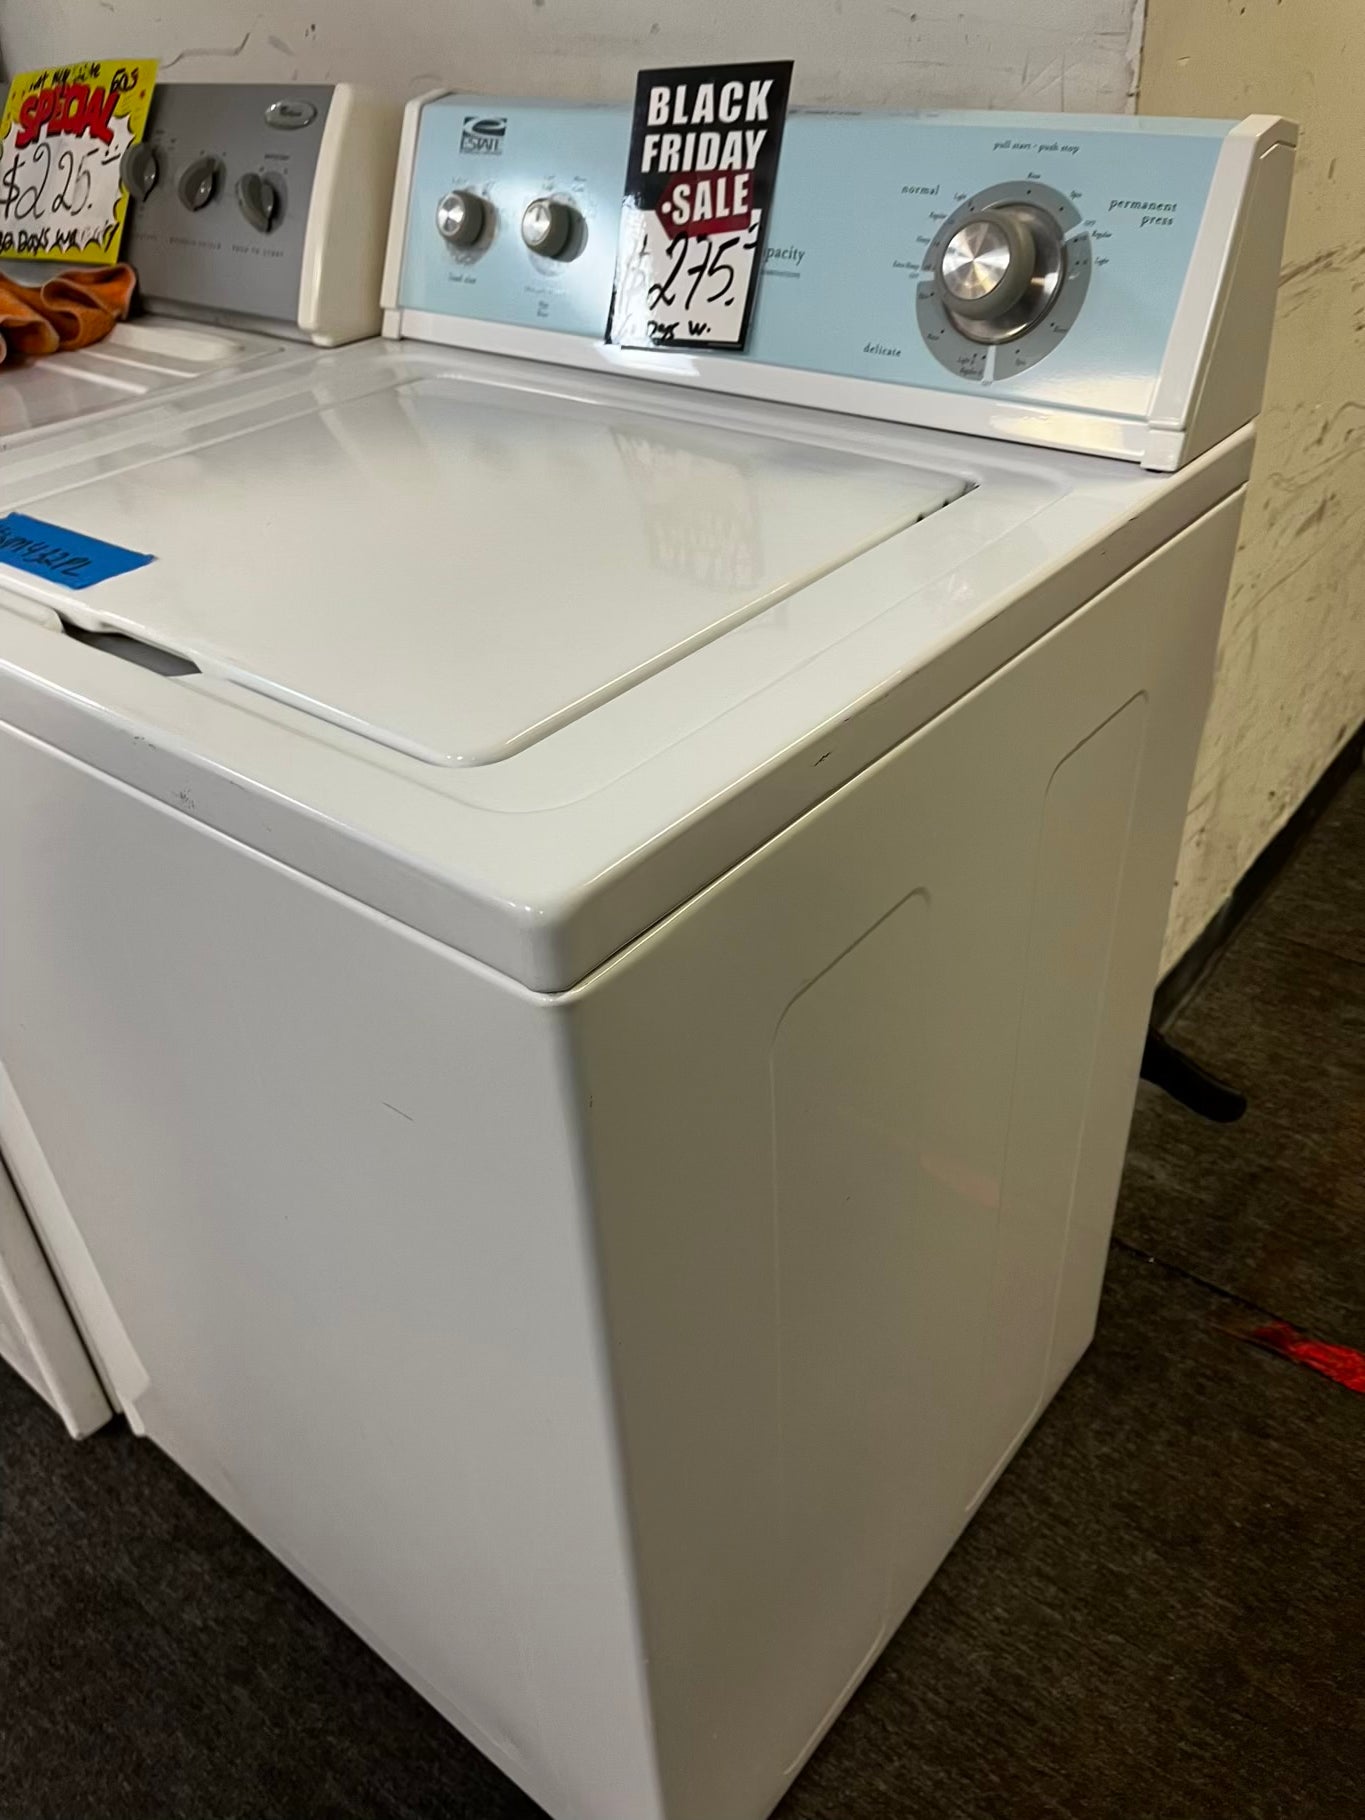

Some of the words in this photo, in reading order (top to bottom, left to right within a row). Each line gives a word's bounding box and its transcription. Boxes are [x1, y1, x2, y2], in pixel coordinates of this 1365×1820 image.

[647, 79, 775, 126] BLACK
[15, 81, 121, 149] SPECIAL
[641, 129, 768, 173] FRIDAY
[672, 172, 750, 225] SALE
[901, 183, 941, 195] normal
[1107, 199, 1178, 213] permanent
[1139, 215, 1174, 229] press
[764, 244, 806, 267] pacity
[863, 342, 902, 358] delicate
